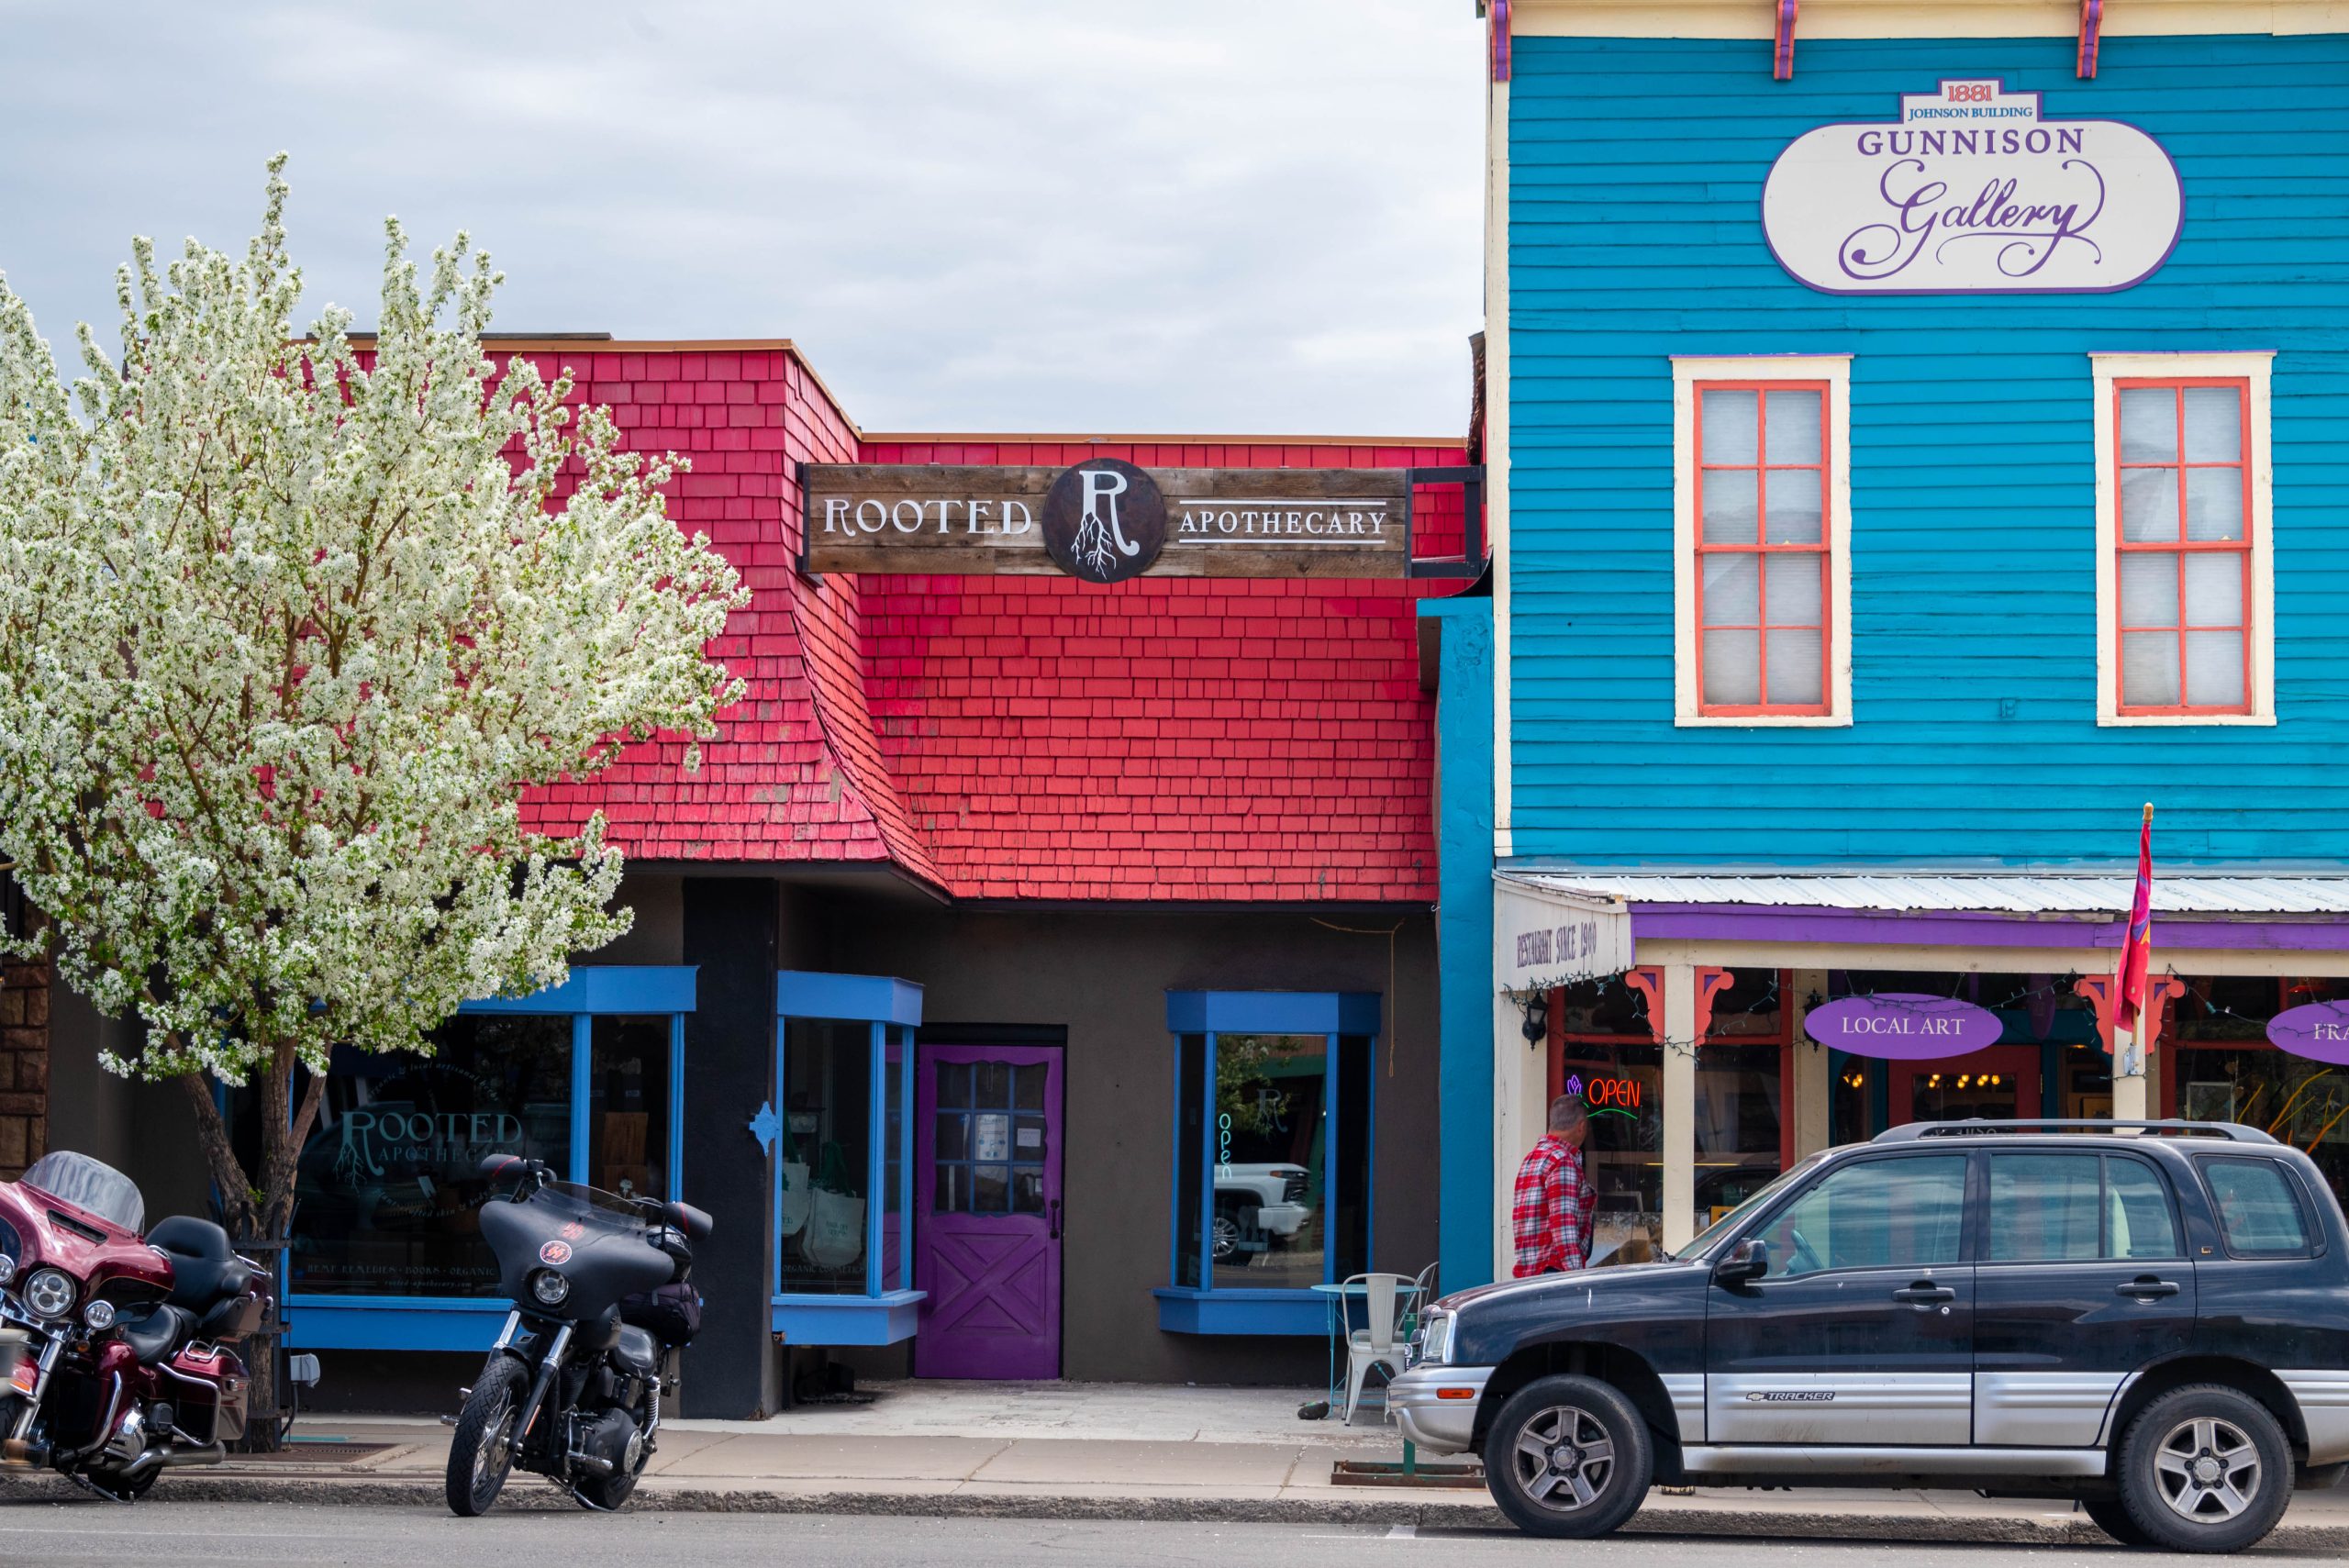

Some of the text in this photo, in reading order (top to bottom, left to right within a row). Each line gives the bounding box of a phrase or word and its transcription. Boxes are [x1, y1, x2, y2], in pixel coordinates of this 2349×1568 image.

[1948, 85, 1992, 102] 1881
[1908, 106, 2033, 121] JOHNSON BUILDING
[1857, 128, 2084, 155] GUNNISON
[1839, 160, 2104, 280] Gallery
[824, 499, 1031, 538] ROOTED
[1070, 470, 1140, 580] R
[1178, 509, 1387, 536] APOTHECARY
[1517, 920, 1597, 969] RESTAURANT SINCE 1900
[1842, 1017, 1965, 1035] LOCAL ART
[1588, 1078, 1641, 1107] OPEN
[338, 1111, 523, 1177] ROOTED
[1219, 1113, 1232, 1180] open
[406, 1265, 440, 1275] BOOKS
[449, 1266, 497, 1276] ORGANIC
[1767, 1392, 1834, 1401] TRACKER
